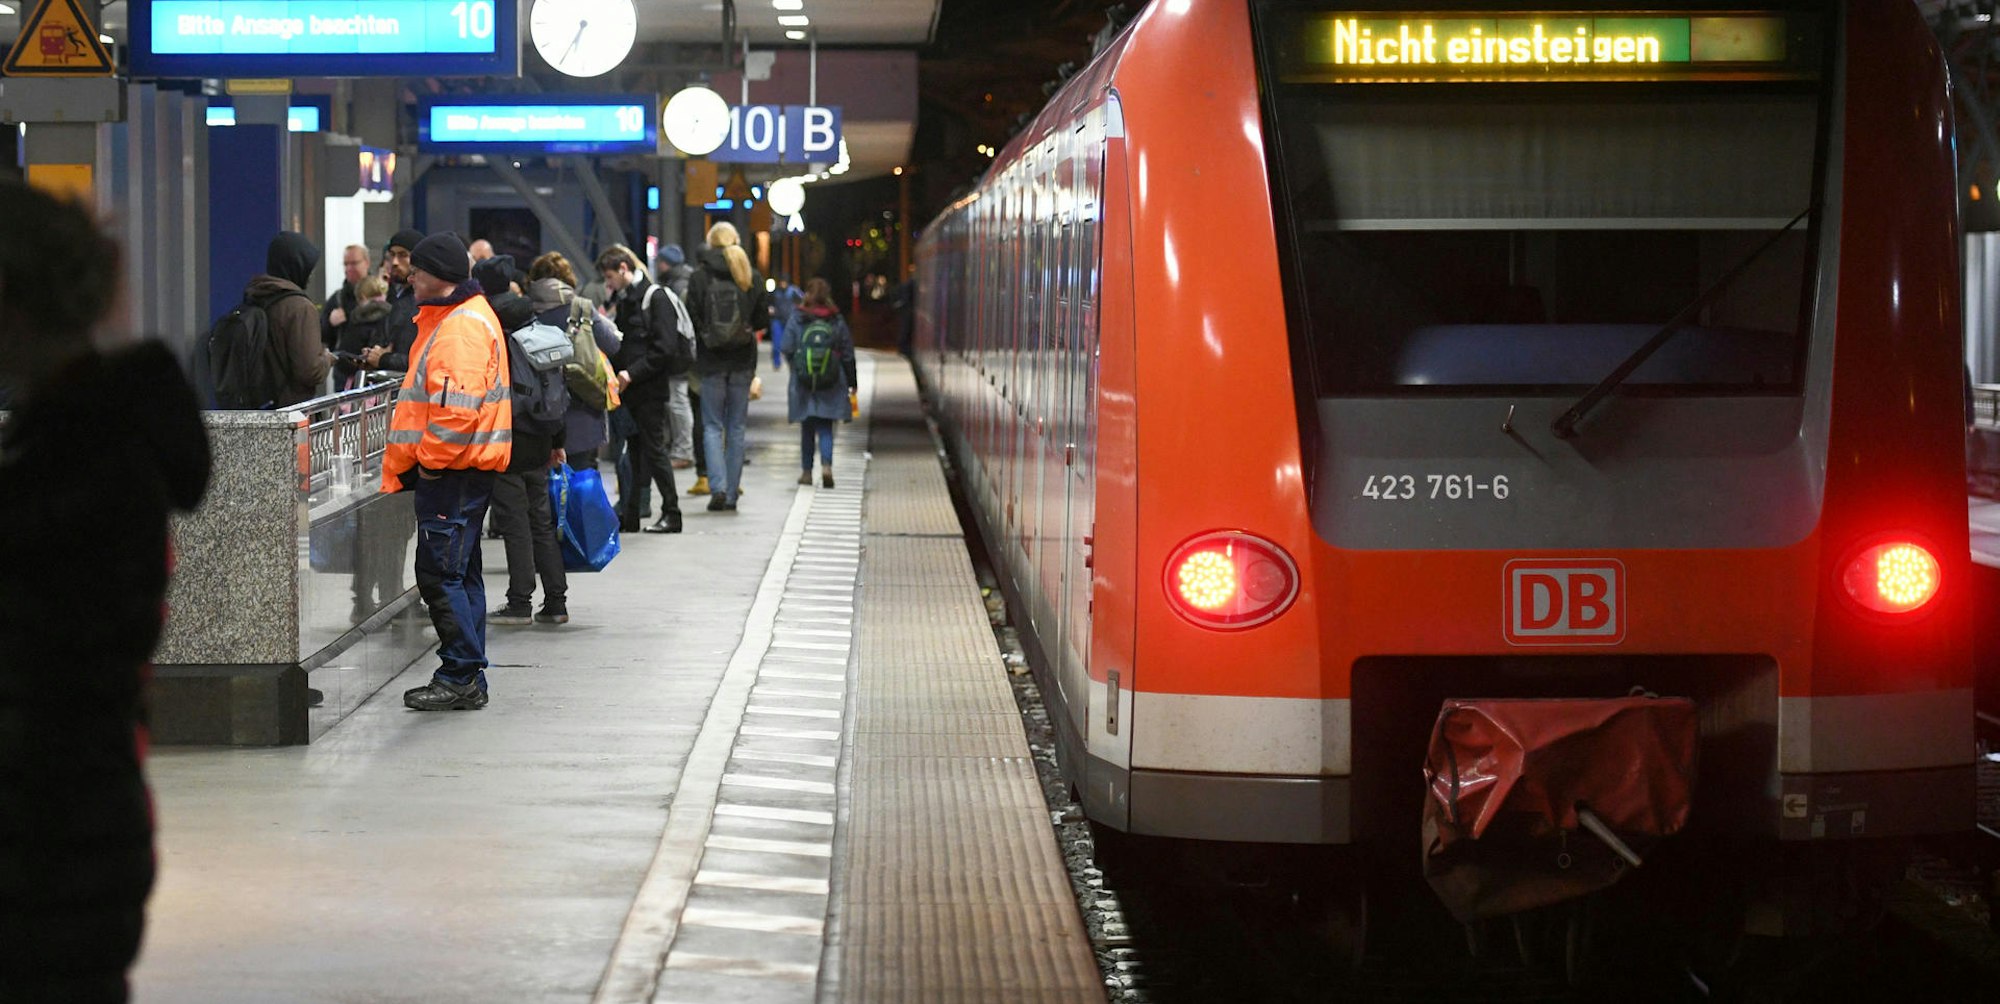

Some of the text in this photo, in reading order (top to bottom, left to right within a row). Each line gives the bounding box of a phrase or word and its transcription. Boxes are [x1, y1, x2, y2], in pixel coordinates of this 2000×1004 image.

[178, 15, 399, 40] Bitte Ansage beachten
[450, 1, 493, 40] 10
[1333, 17, 1660, 65] Nicht einsteigen
[615, 106, 644, 132] 10
[729, 105, 837, 152] 10 B
[1361, 474, 1510, 500] 423 761-6
[1519, 573, 1611, 630] DB
